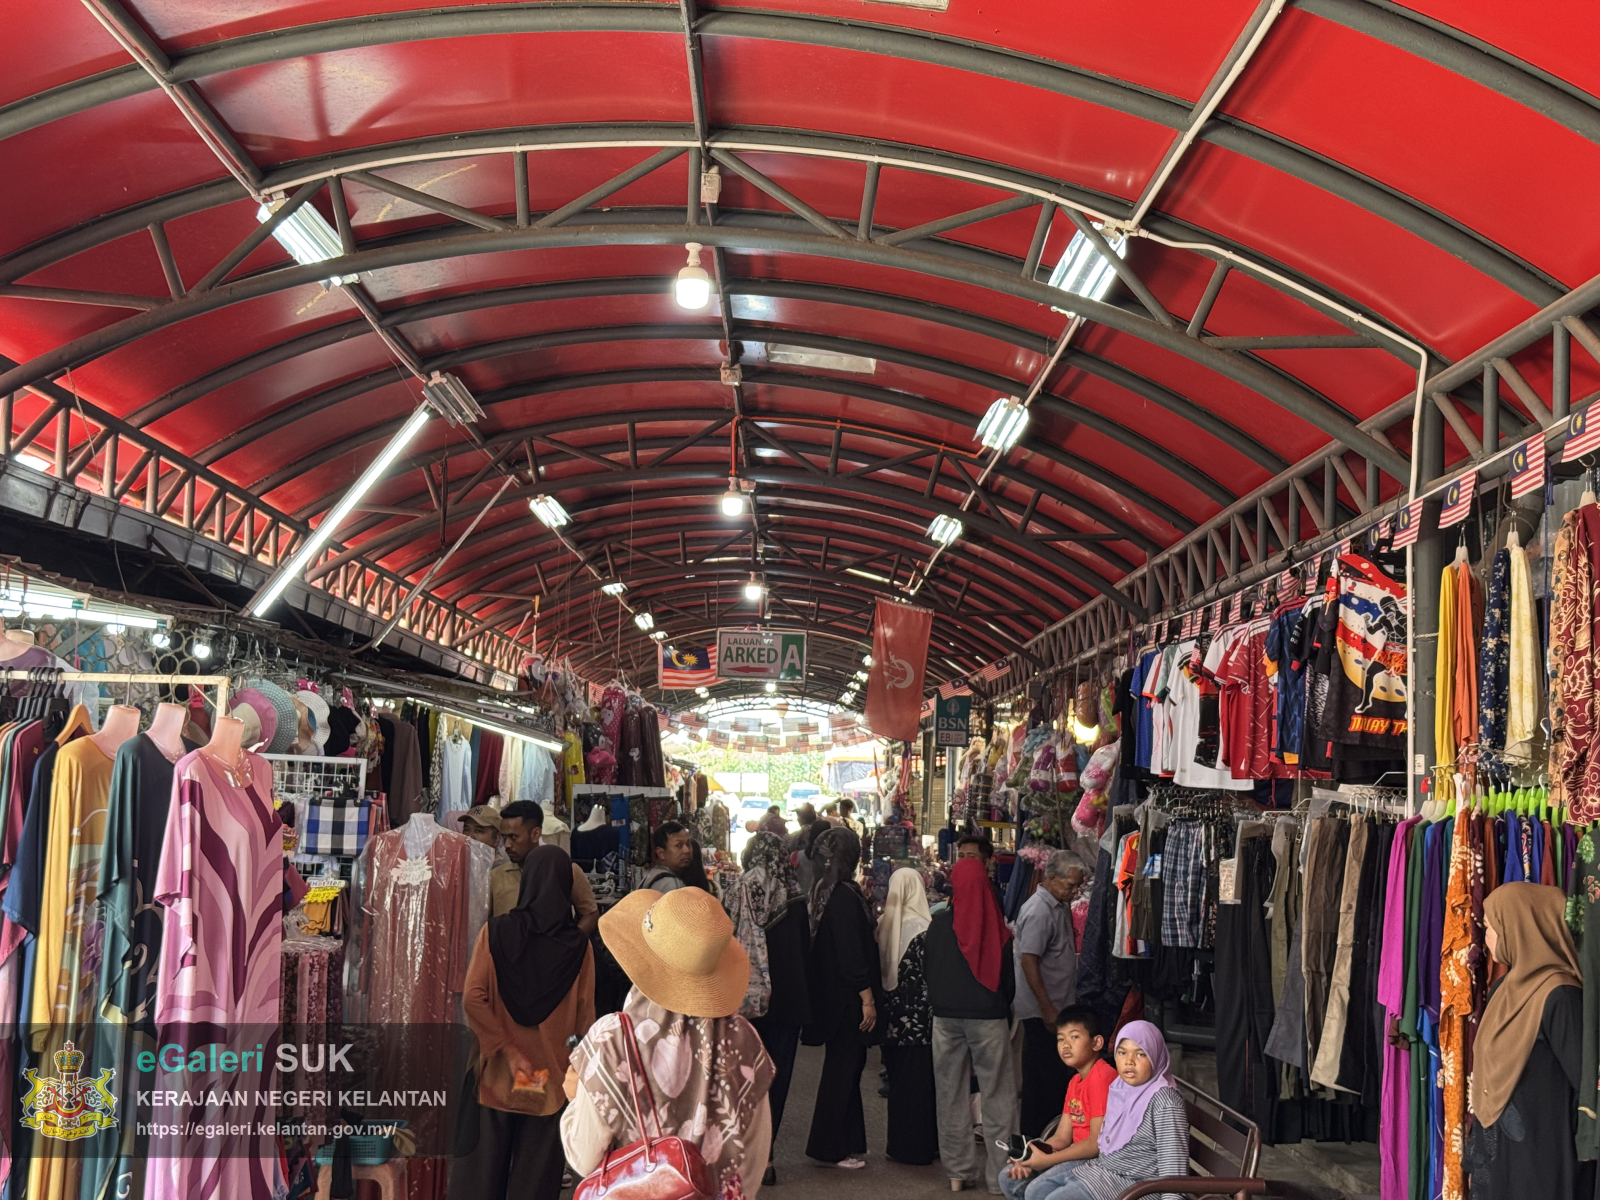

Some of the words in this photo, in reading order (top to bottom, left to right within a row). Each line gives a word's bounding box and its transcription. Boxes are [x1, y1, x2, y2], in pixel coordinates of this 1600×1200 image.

[727, 637, 762, 646] LALUAN
[722, 646, 779, 664] ARKED
[782, 644, 802, 670] A
[938, 716, 967, 730] BSN
[1348, 714, 1391, 735] MUAY
[1391, 717, 1415, 736] TH
